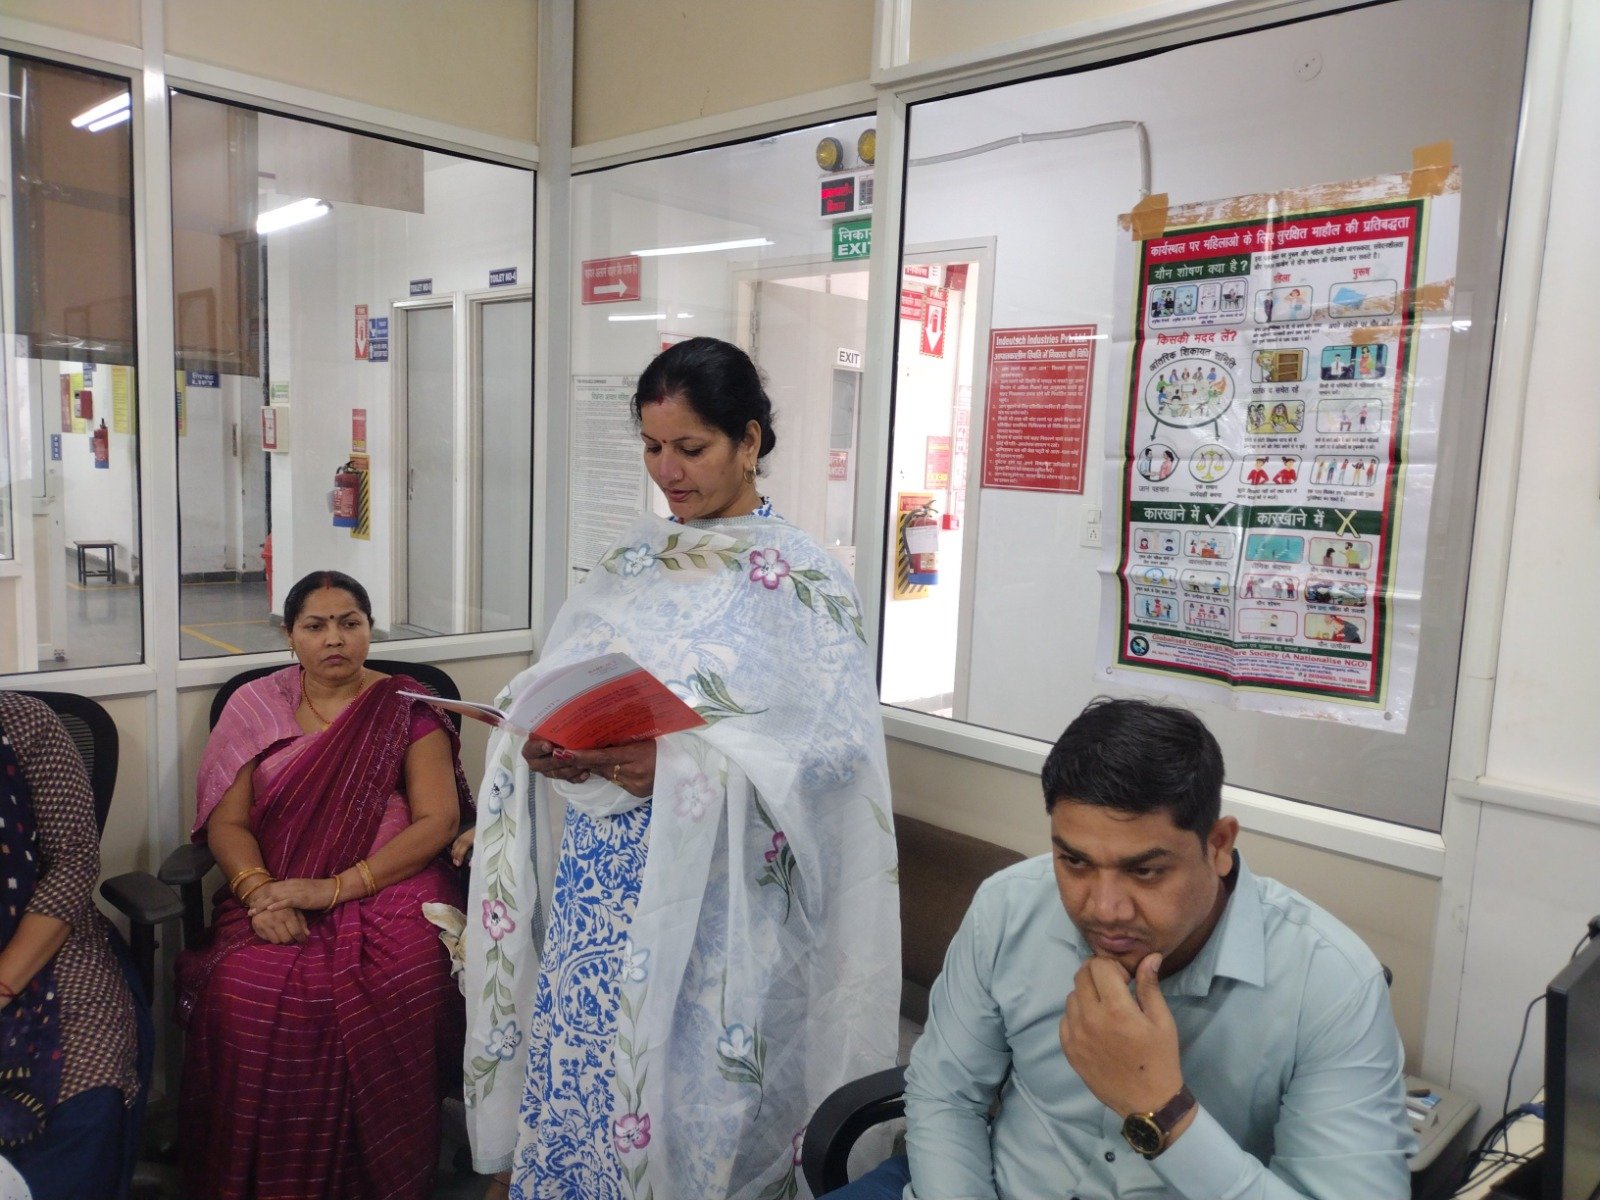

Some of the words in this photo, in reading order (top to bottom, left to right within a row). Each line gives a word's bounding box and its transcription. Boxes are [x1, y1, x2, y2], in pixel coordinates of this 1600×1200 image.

[838, 227, 872, 242] निका
[1151, 241, 1186, 256] कार्यस्थल
[1189, 241, 1200, 251] पर
[1243, 230, 1253, 245] के
[1277, 226, 1308, 245] सुरक्षित
[1312, 221, 1341, 237] माहौल
[1345, 219, 1359, 233] की
[1363, 216, 1410, 232] प्रतिबद्धता
[1155, 266, 1173, 279] यौन
[1177, 264, 1204, 277] शोषण
[1208, 263, 1225, 274] क्या
[1027, 333, 1059, 344] Industries
[1157, 332, 1190, 345] किसकी
[1194, 332, 1215, 343] मदद
[839, 350, 860, 364] EXIT
[1180, 346, 1211, 357] शिकायत
[1143, 504, 1186, 521] कारखाने
[1190, 504, 1200, 521] में
[1257, 509, 1307, 526] कारखाने
[1314, 508, 1325, 528] में
[1249, 650, 1279, 659] Society
[1294, 654, 1341, 665] Nationalise
[1345, 660, 1368, 669] NGO)
